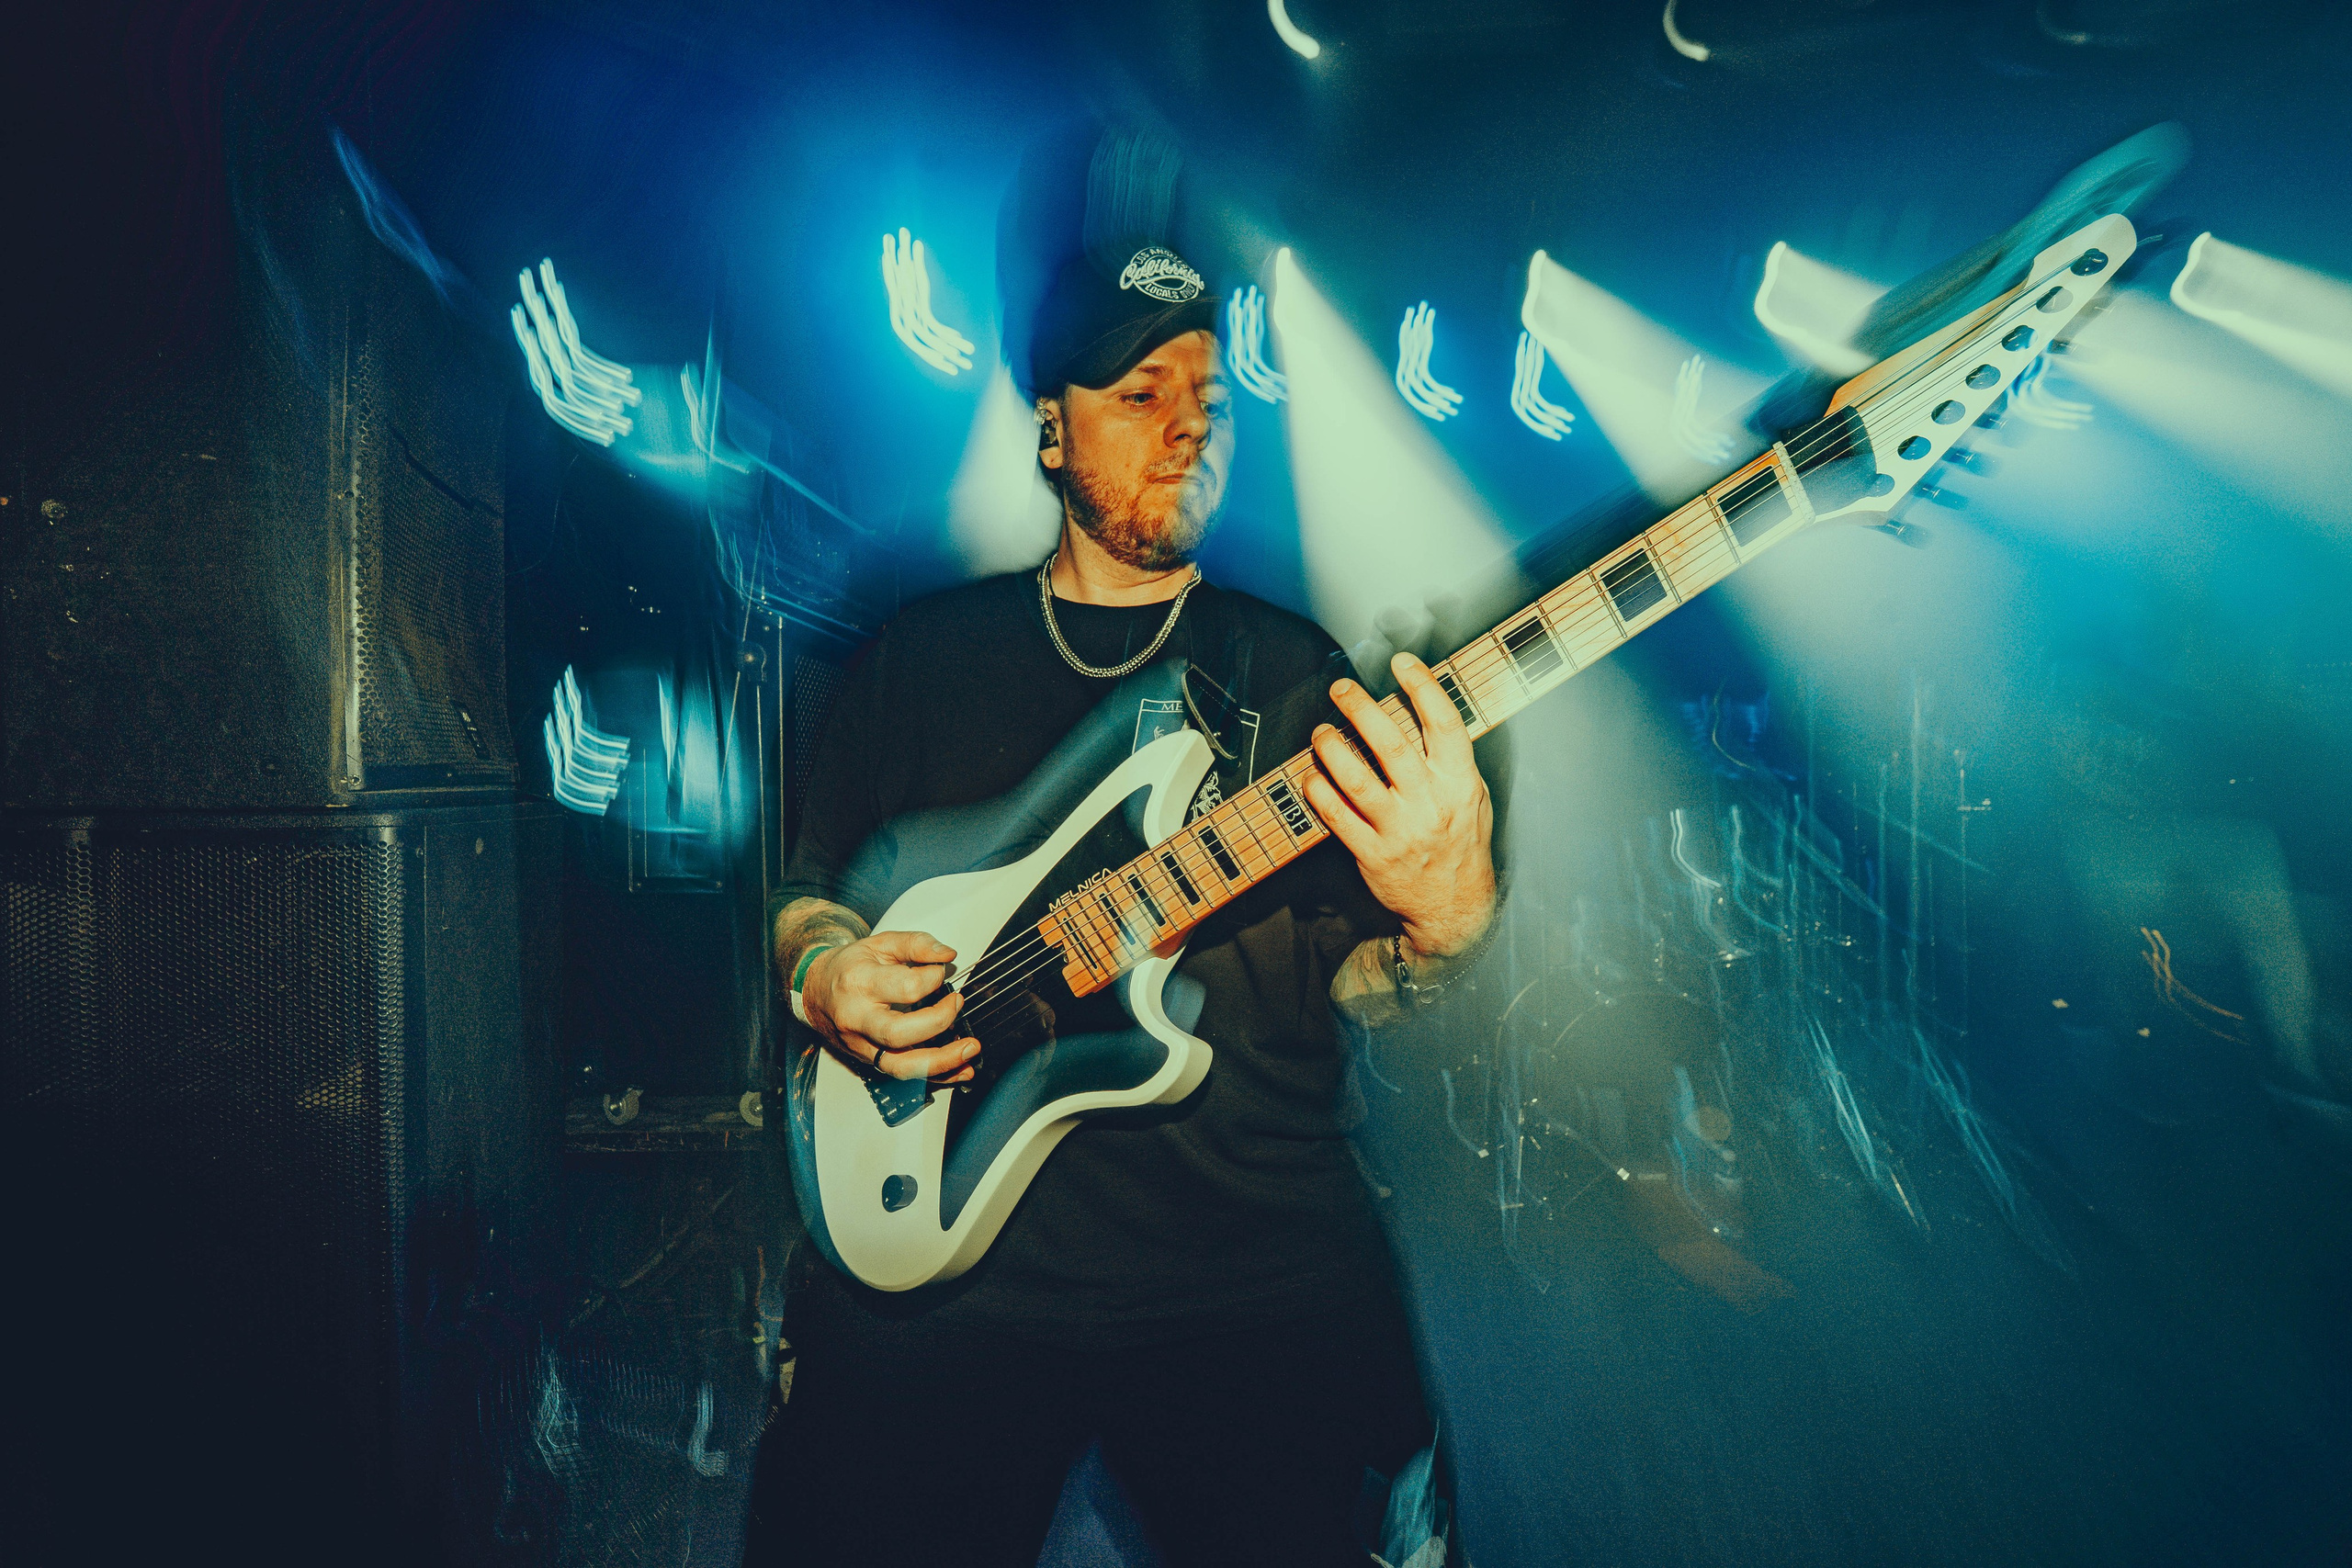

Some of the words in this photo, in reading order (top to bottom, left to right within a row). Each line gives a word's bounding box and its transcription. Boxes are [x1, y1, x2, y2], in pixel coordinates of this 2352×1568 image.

[1135, 252, 1149, 265] LOS
[1119, 258, 1204, 290] California
[1145, 283, 1179, 299] LOCALS
[1180, 283, 1196, 299] ONLY
[1048, 867, 1112, 912] MELNICA
